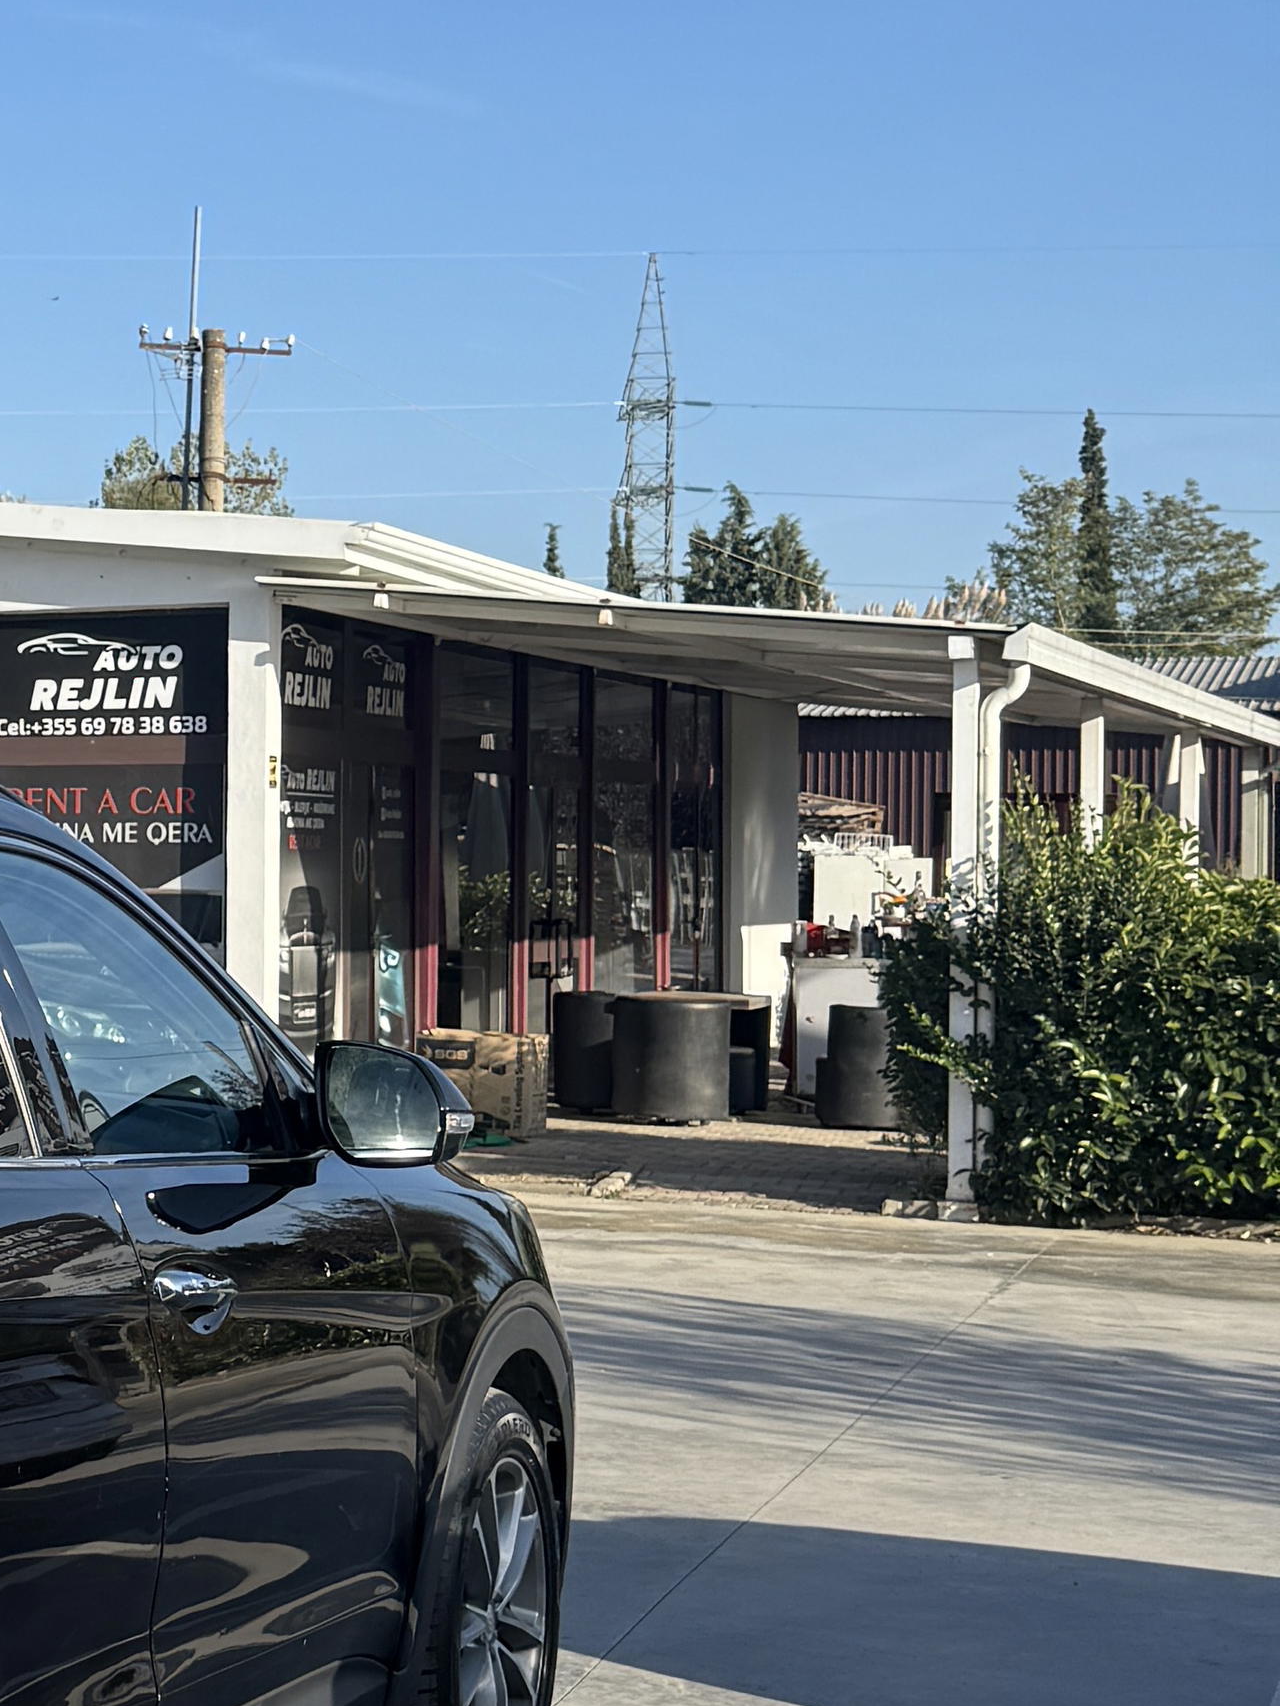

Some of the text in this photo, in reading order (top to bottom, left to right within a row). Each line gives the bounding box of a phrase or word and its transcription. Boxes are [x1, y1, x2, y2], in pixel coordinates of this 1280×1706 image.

[93, 645, 184, 672] AUTO
[305, 644, 333, 670] AUTO
[30, 676, 178, 711] REJLIN
[284, 671, 332, 710] REJLIN
[80, 717, 106, 736] 69
[110, 717, 135, 735] 78
[139, 716, 164, 734] 38
[168, 715, 208, 734] 638
[97, 788, 119, 815] A
[130, 786, 197, 815] CAR
[102, 822, 138, 844] ME
[146, 821, 213, 845] QERA
